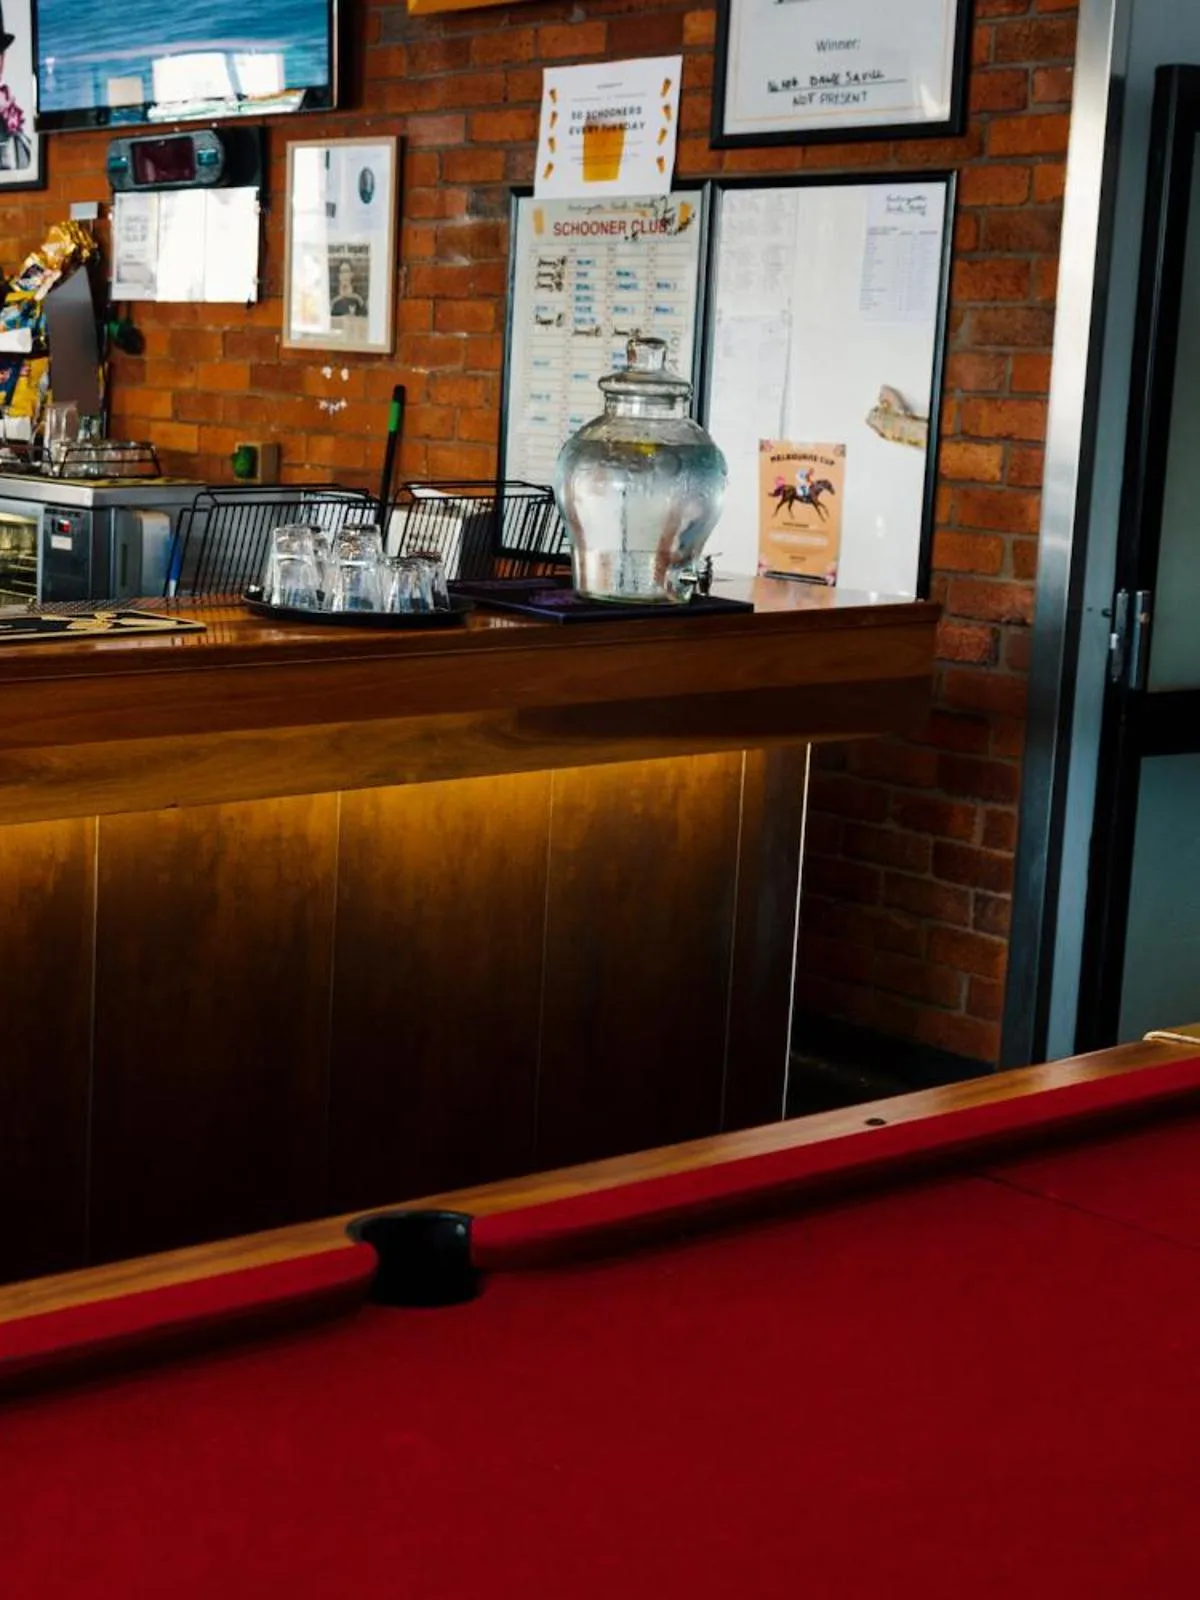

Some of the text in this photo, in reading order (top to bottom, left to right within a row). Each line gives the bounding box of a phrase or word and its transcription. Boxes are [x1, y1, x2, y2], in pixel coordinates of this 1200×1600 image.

[815, 38, 861, 53] Winner:
[585, 106, 642, 121] SCHOONERS
[569, 124, 599, 136] EVERY
[553, 218, 668, 237] SCHOONER CLUB
[770, 452, 836, 467] MELBOURNE CUP
